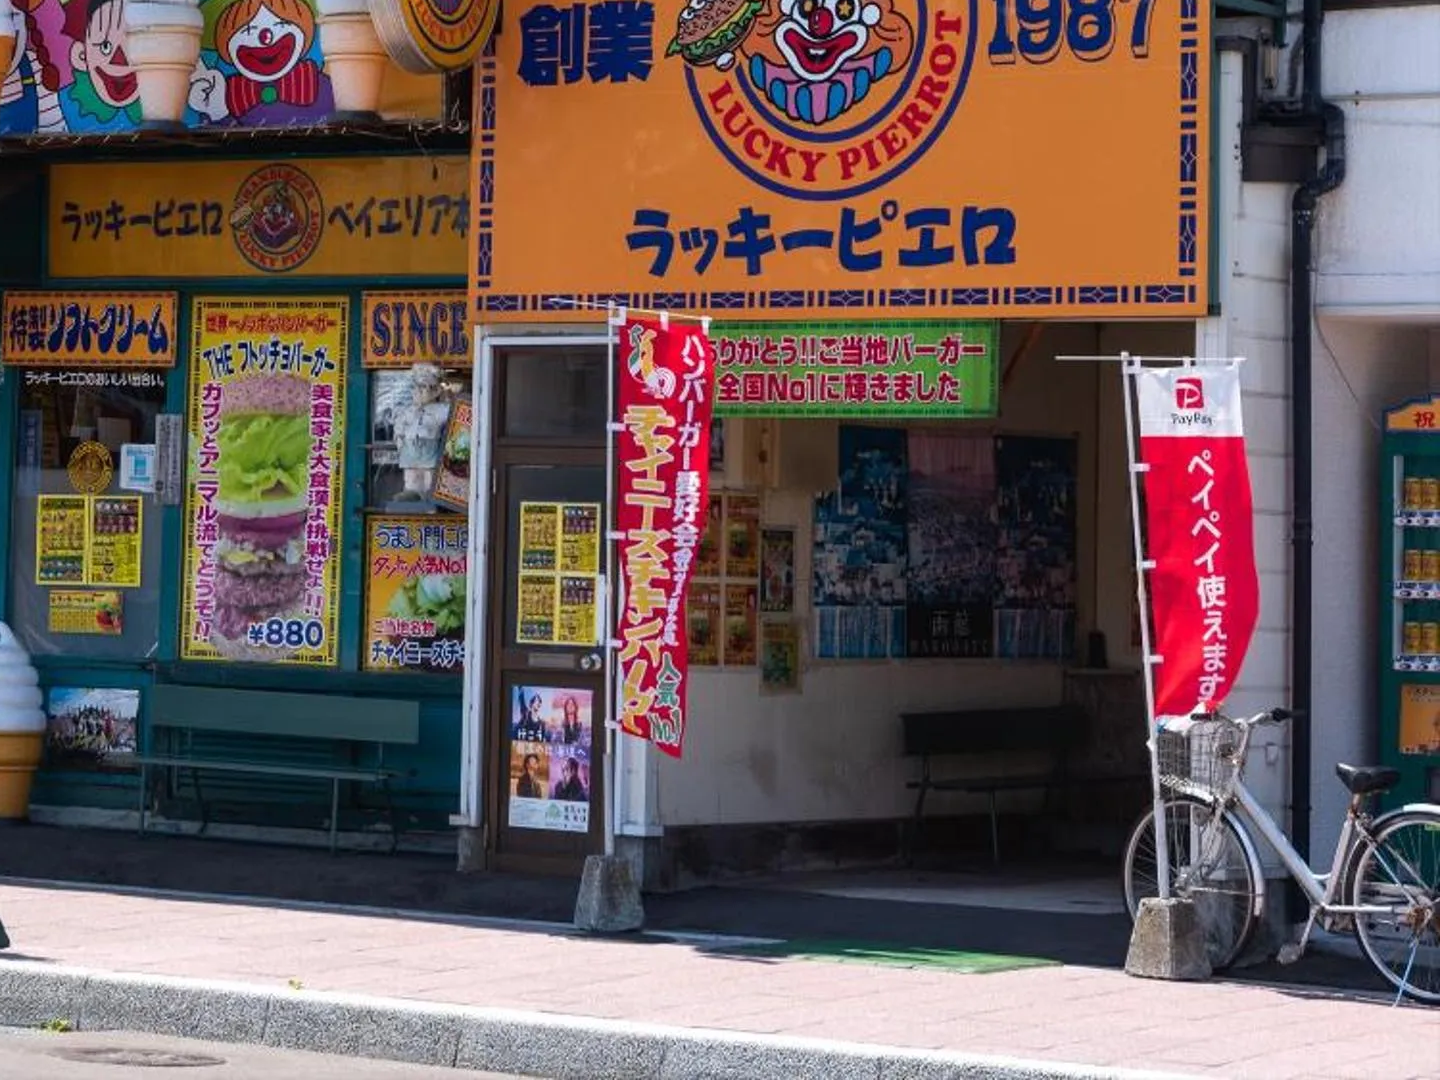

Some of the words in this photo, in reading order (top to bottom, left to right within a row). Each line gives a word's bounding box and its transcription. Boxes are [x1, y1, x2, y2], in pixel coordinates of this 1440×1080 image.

[516, 0, 656, 87] 創業
[708, 79, 828, 182] LUCKY
[836, 9, 962, 181] PIERROT
[61, 200, 222, 242] ラッキーピエロ
[625, 199, 1018, 276] ラッキーピエロ
[371, 301, 469, 356] SINCE
[202, 343, 235, 379] THE
[237, 339, 336, 378] フトッチョバーガー
[1171, 412, 1214, 427] PayPay
[1187, 449, 1228, 702] ペイペイ使えます
[248, 618, 324, 648] ¥880
